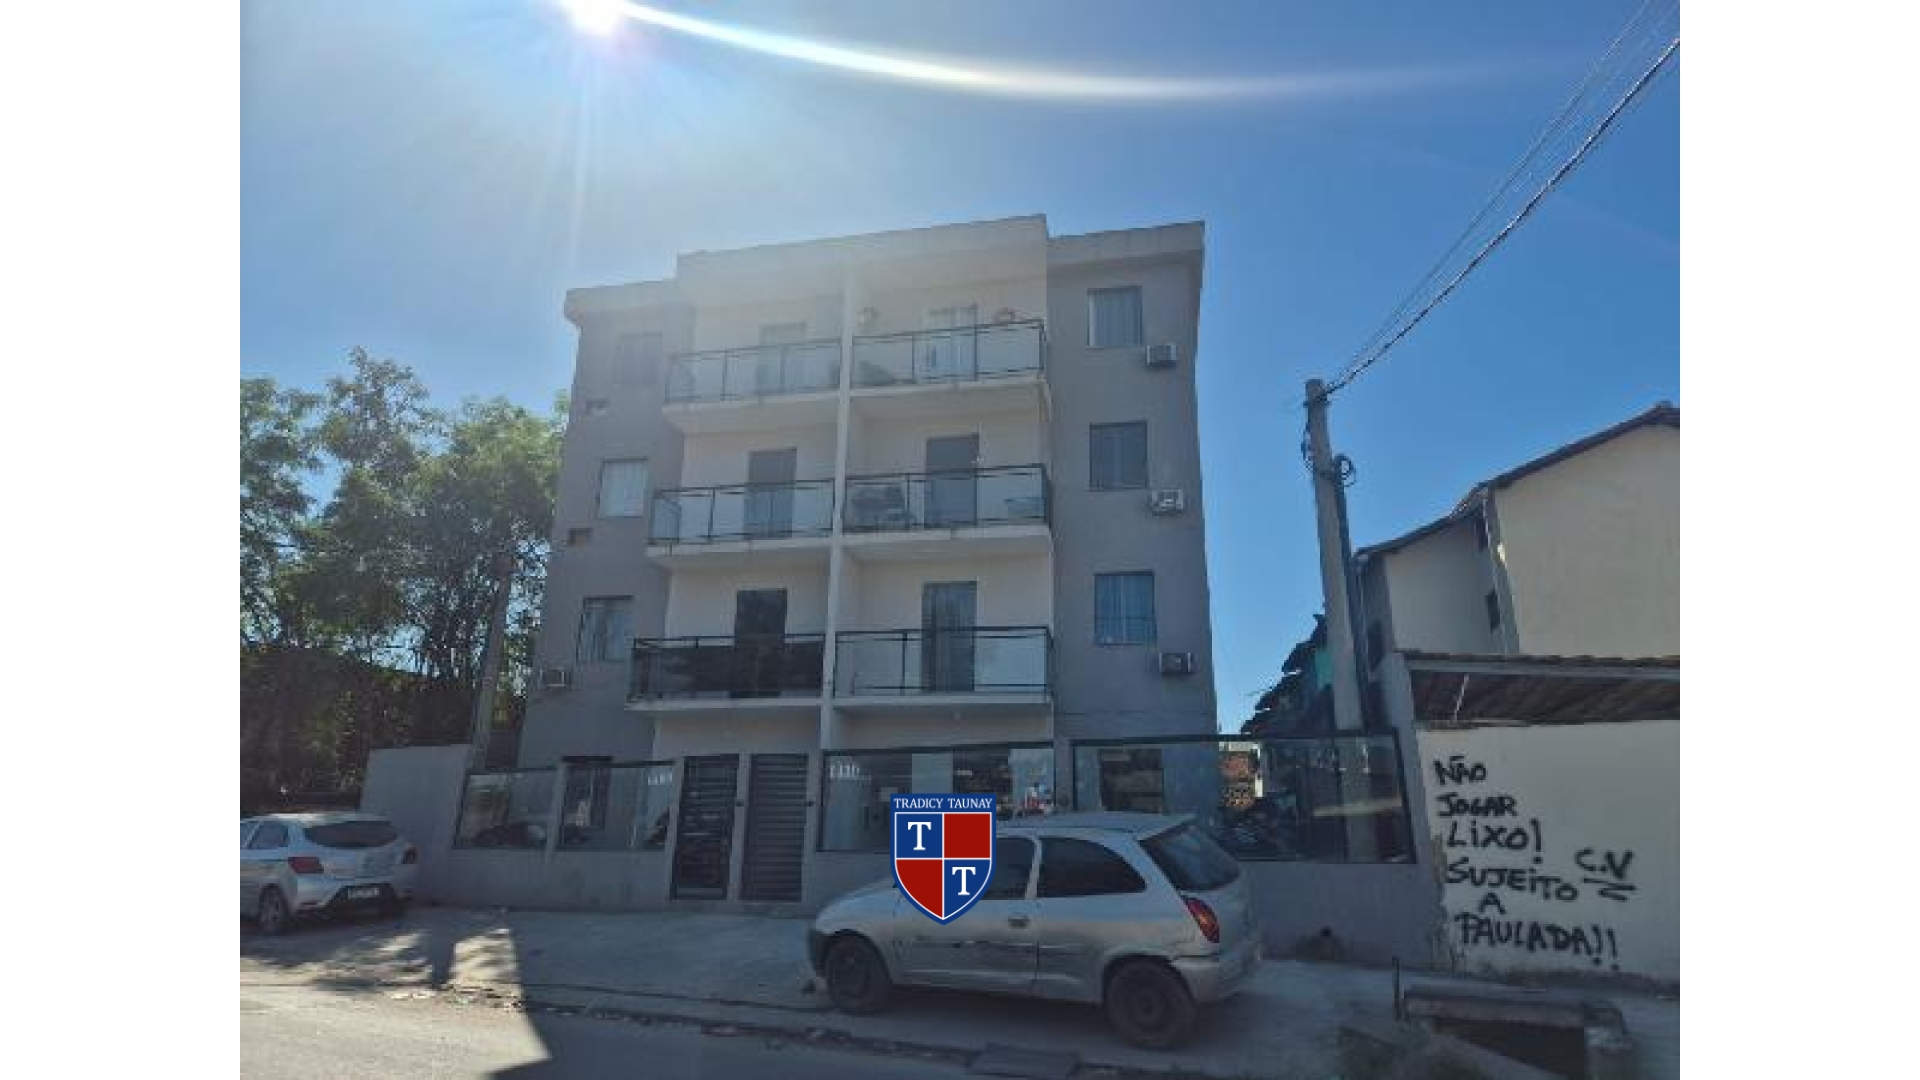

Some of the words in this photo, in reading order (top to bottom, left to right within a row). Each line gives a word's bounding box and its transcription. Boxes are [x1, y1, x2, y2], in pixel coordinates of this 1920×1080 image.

[1434, 756, 1487, 785] NÃO
[1436, 792, 1518, 817] JOGAR
[1478, 892, 1506, 914] A
